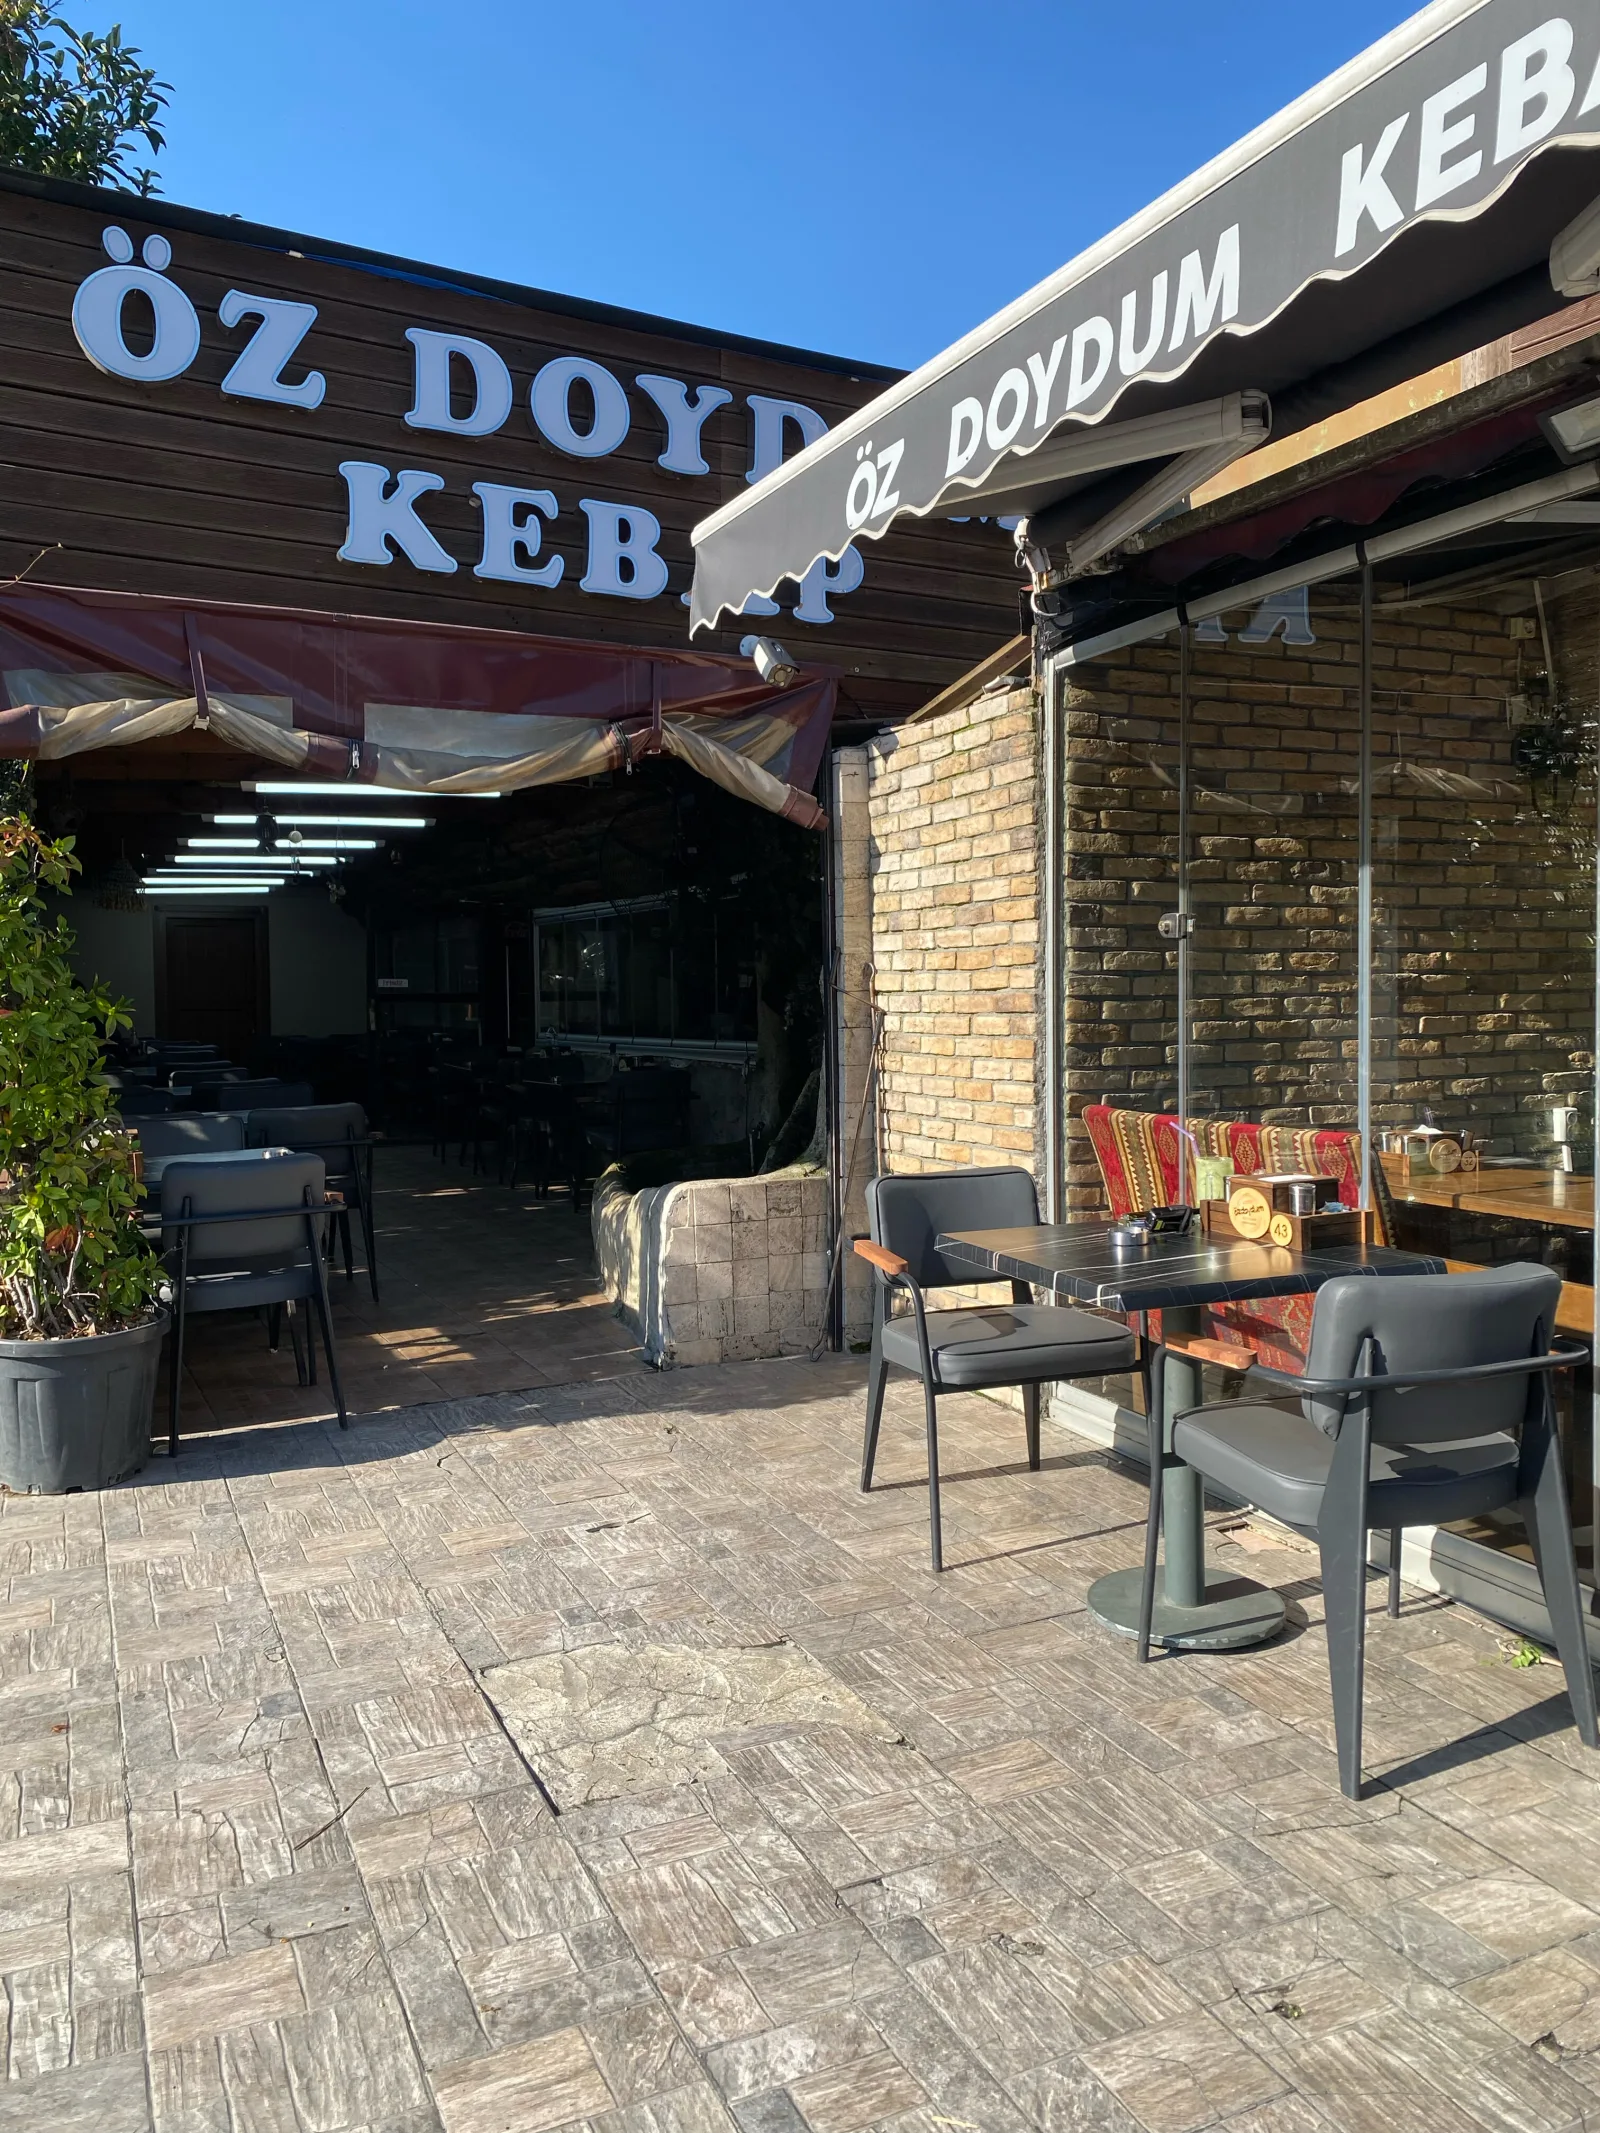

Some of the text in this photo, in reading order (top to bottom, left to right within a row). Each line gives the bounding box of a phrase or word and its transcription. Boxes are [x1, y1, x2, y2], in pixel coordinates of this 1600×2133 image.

[72, 225, 326, 410] ÖZ
[845, 439, 905, 530] ÖZ
[944, 223, 1240, 479] DOYDUM
[338, 461, 865, 623] KEBP
[1274, 1223, 1288, 1238] 43
